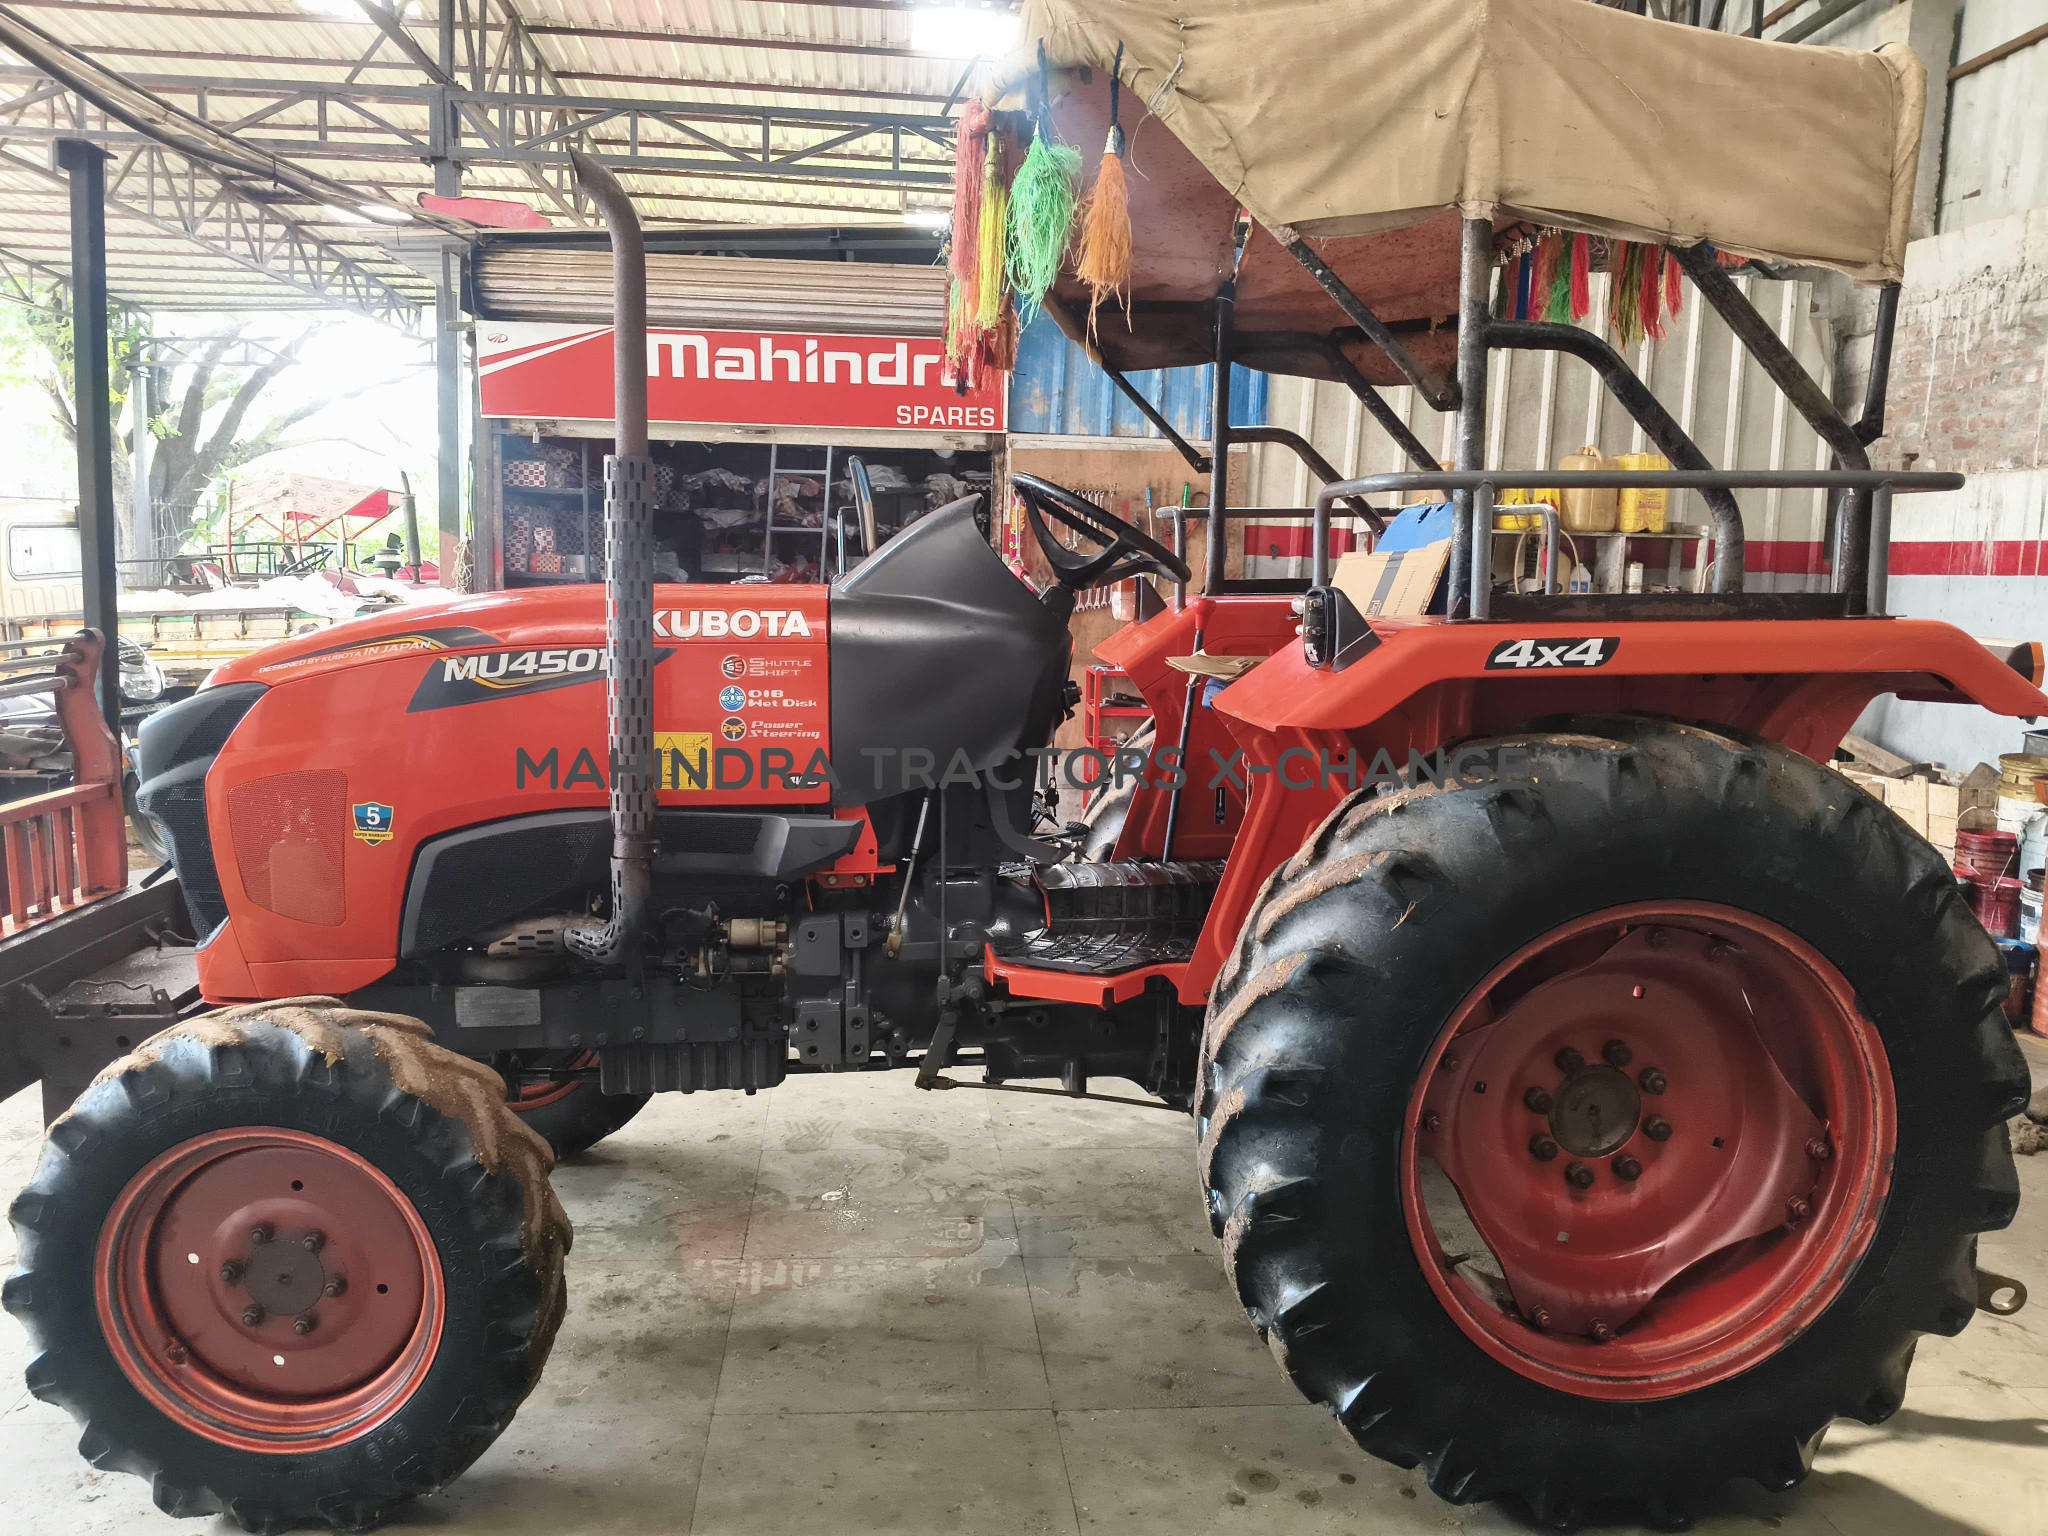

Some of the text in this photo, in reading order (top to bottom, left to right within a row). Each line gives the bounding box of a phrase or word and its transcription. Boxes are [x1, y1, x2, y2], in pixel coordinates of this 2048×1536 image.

[896, 405, 995, 427] SPARES
[259, 640, 432, 674] DESIGNED BY KUBOTA IN JAPAN
[1494, 638, 1604, 668] 4x4
[748, 698, 817, 708] Wet Disk
[748, 729, 820, 740] Steering
[751, 720, 803, 730] Power
[366, 806, 381, 825] 5
